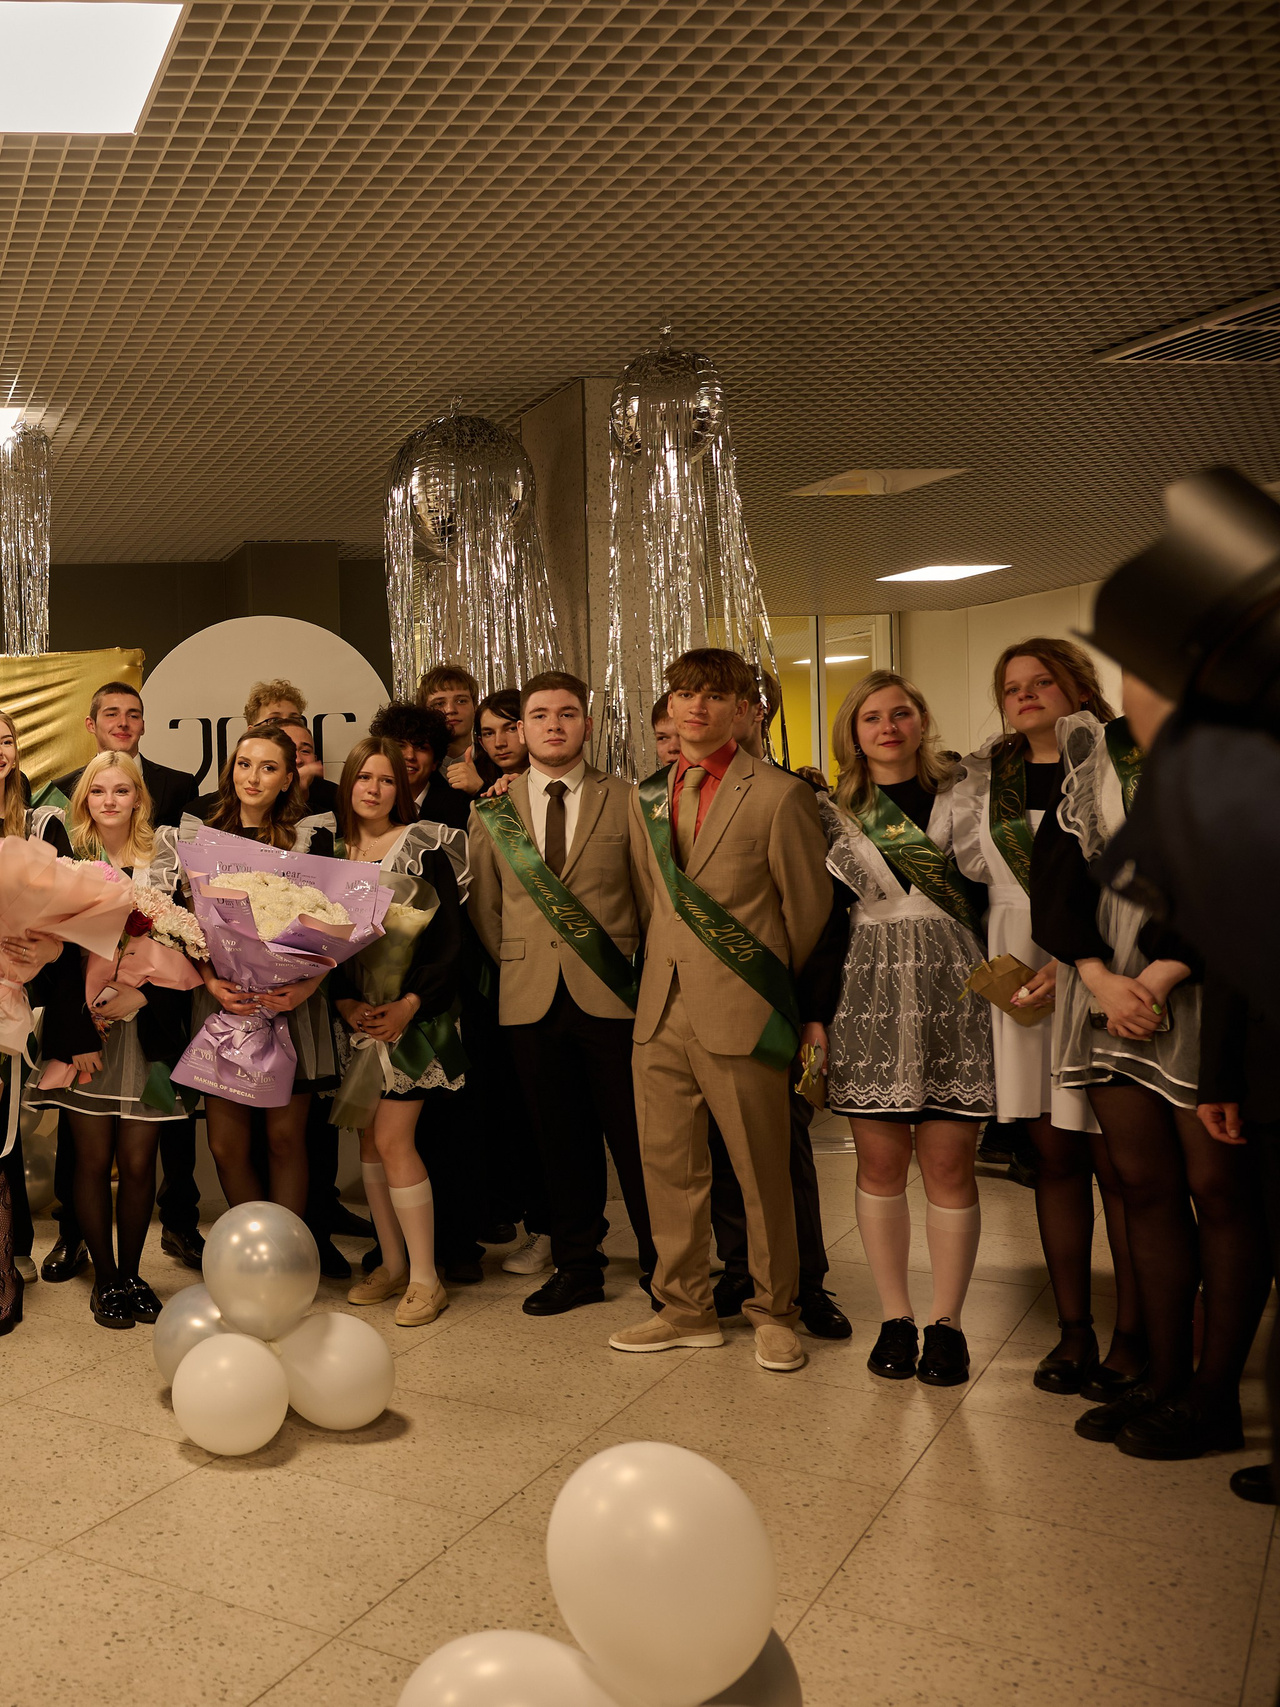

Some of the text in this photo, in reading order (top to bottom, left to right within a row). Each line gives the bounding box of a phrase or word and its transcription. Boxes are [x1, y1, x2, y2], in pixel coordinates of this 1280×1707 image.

[169, 712, 356, 790] 26
[998, 788, 1031, 870] Выпуск
[899, 844, 973, 911] Выпуск
[551, 903, 597, 938] 2026
[707, 923, 763, 962] 2026
[193, 1075, 218, 1088] MAKING
[228, 1087, 256, 1099] SPECIAL
